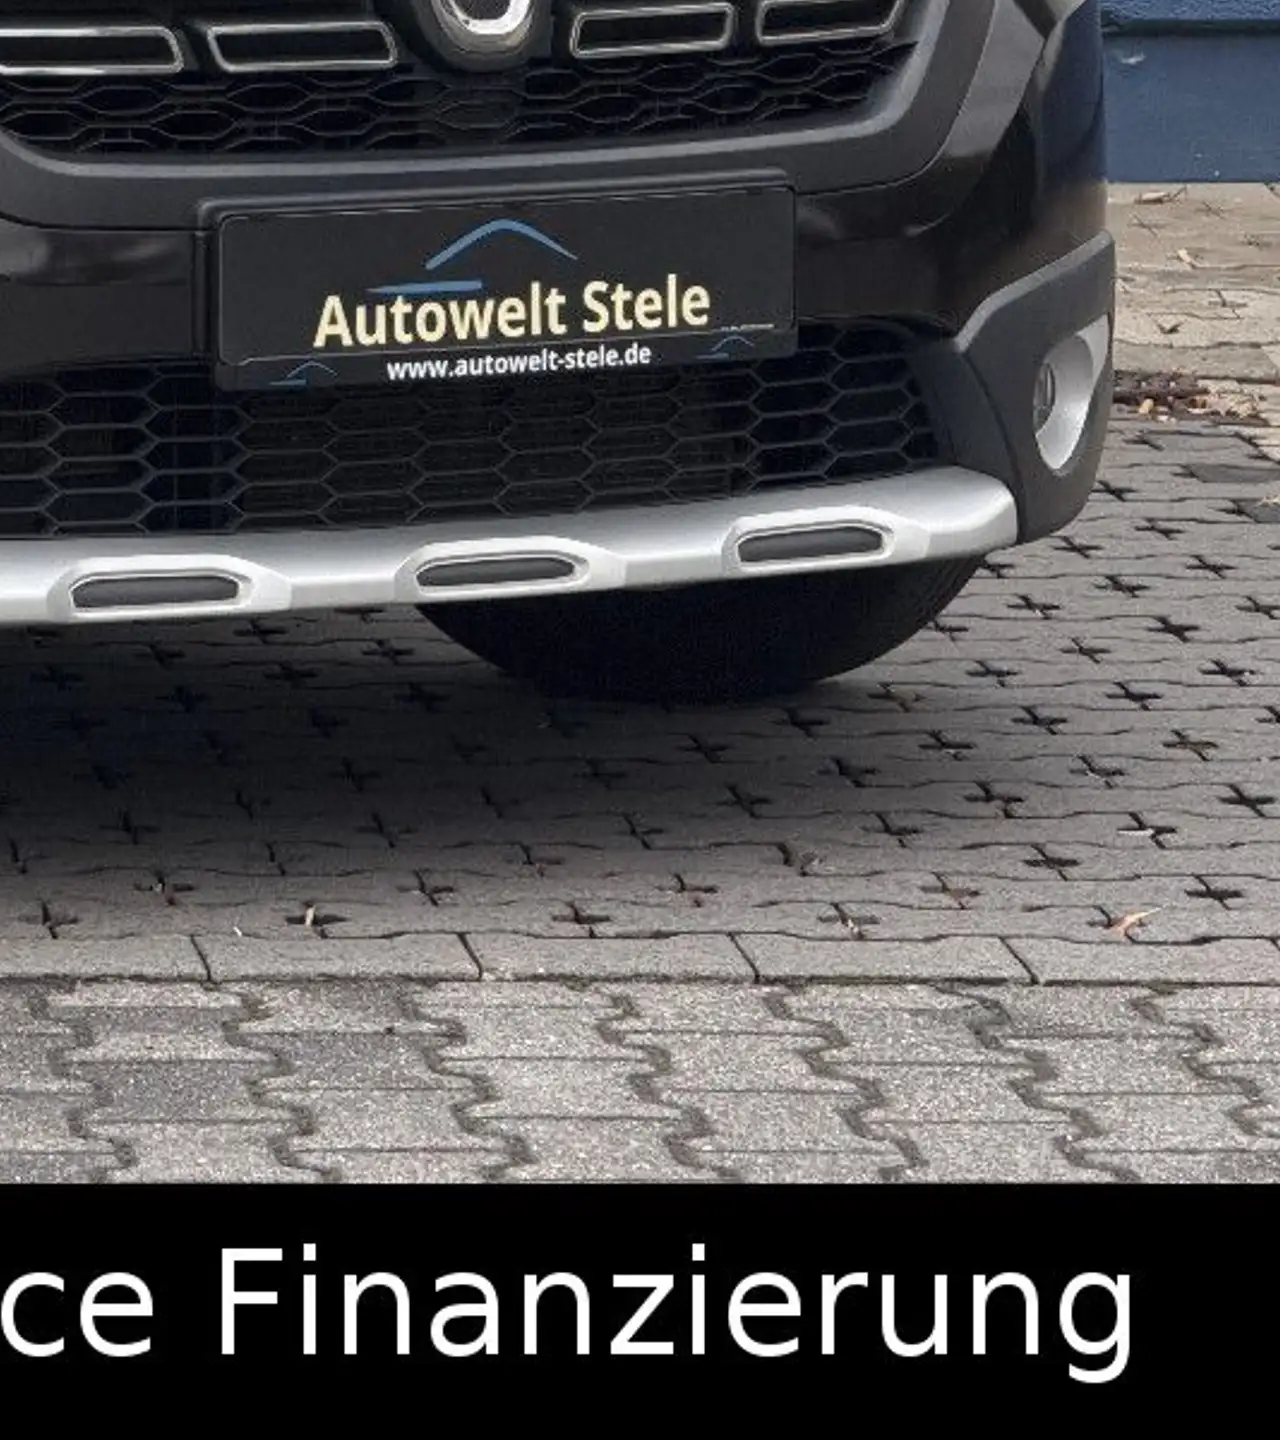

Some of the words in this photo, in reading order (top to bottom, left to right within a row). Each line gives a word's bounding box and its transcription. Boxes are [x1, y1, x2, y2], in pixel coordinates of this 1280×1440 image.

[312, 280, 567, 349] Autowelt
[582, 273, 711, 333] Stele
[386, 342, 653, 381] www.autowelt-stele.de
